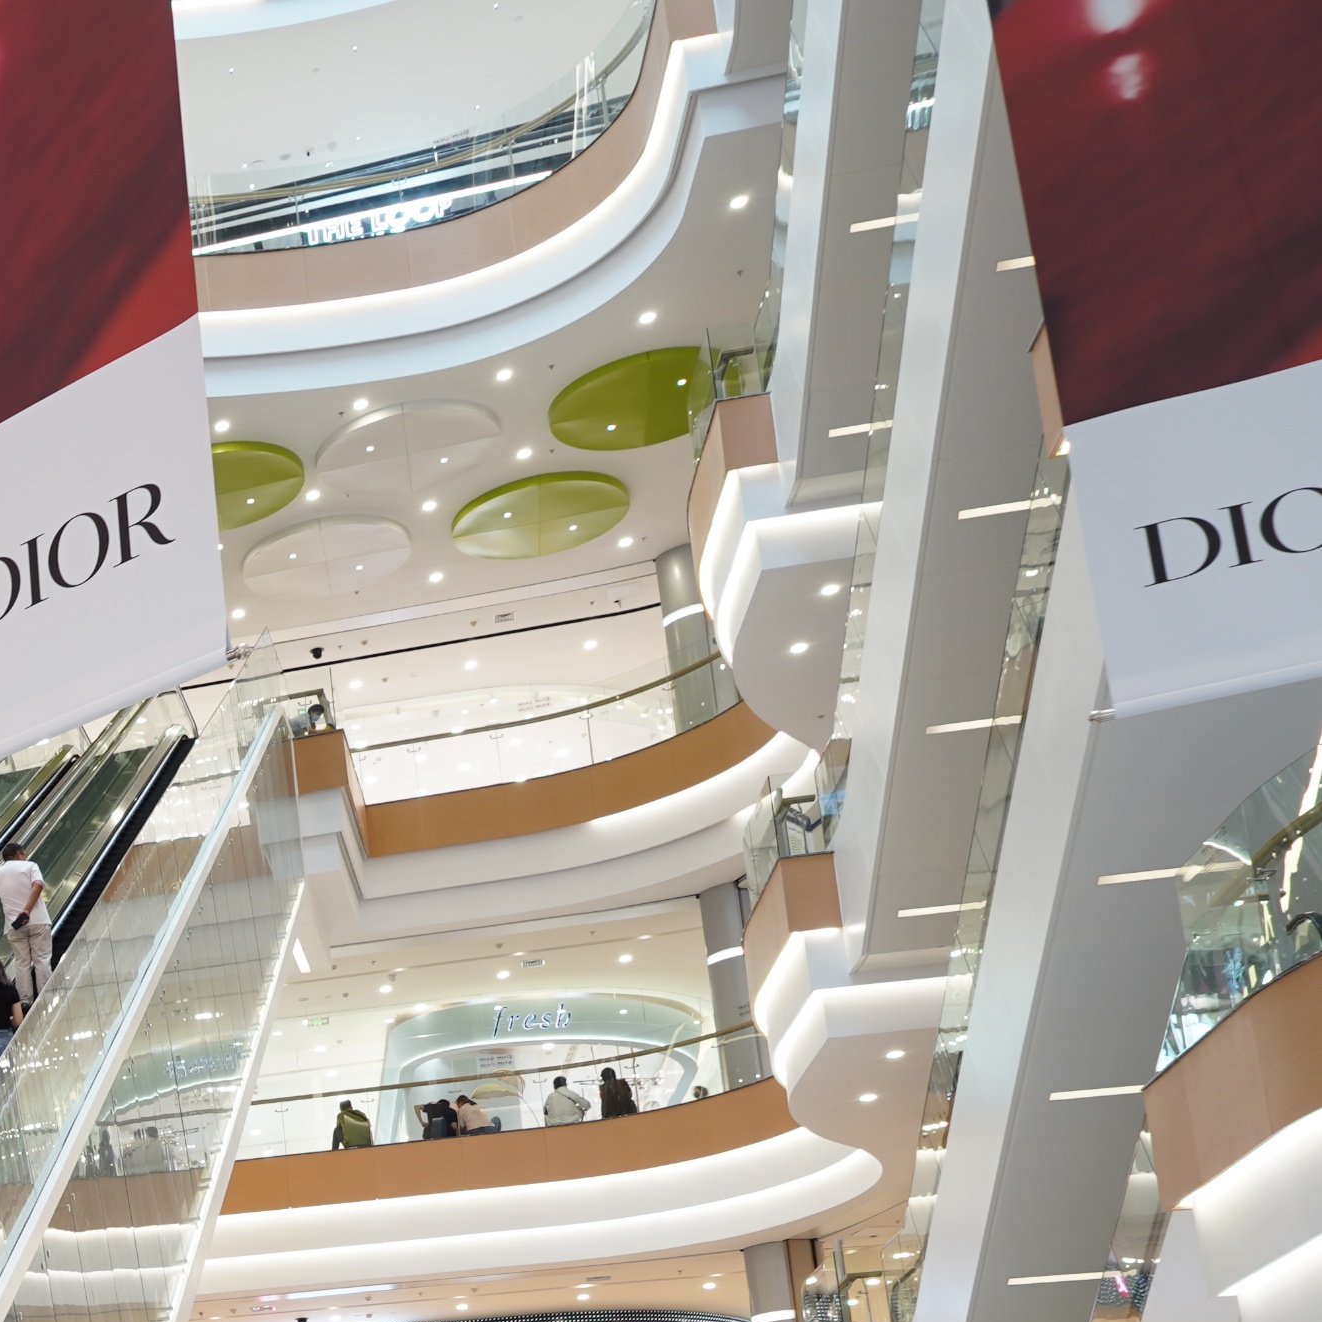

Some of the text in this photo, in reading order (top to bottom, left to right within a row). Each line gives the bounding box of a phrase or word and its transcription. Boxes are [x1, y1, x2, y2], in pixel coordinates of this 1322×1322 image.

[307, 220, 364, 246] THE
[370, 198, 453, 233] LOOP
[1133, 486, 1322, 588] DIO
[493, 1003, 571, 1038] fresh
